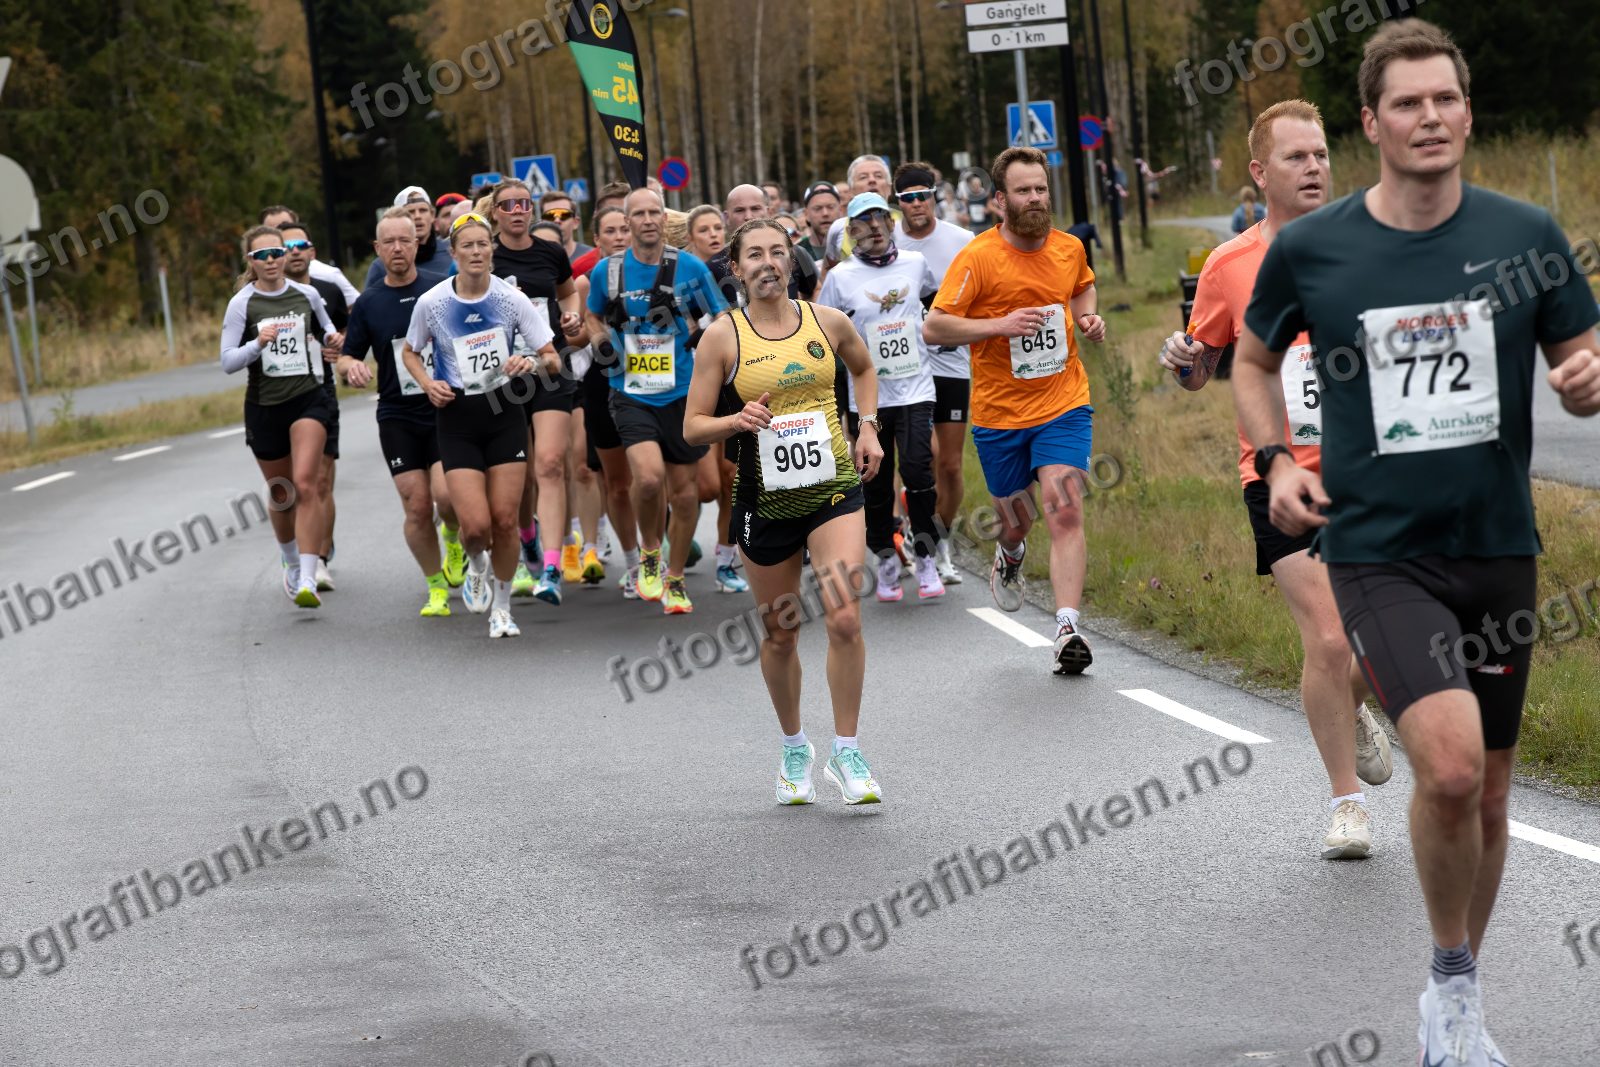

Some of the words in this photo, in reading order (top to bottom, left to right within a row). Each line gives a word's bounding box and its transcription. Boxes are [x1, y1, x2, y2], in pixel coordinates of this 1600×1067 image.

[986, 3, 1046, 20] Gangfelt
[1025, 31, 1046, 43] km
[270, 337, 298, 355] 452
[880, 337, 909, 359] 628
[1021, 329, 1057, 353] 645
[468, 350, 500, 373] 725
[628, 356, 670, 371] PACE
[745, 355, 769, 366] CRAFT
[1394, 351, 1471, 397] 772
[771, 417, 815, 432] NORGES
[1427, 411, 1495, 432] Aurskog
[777, 426, 810, 438] LØPET
[774, 441, 822, 472] 905
